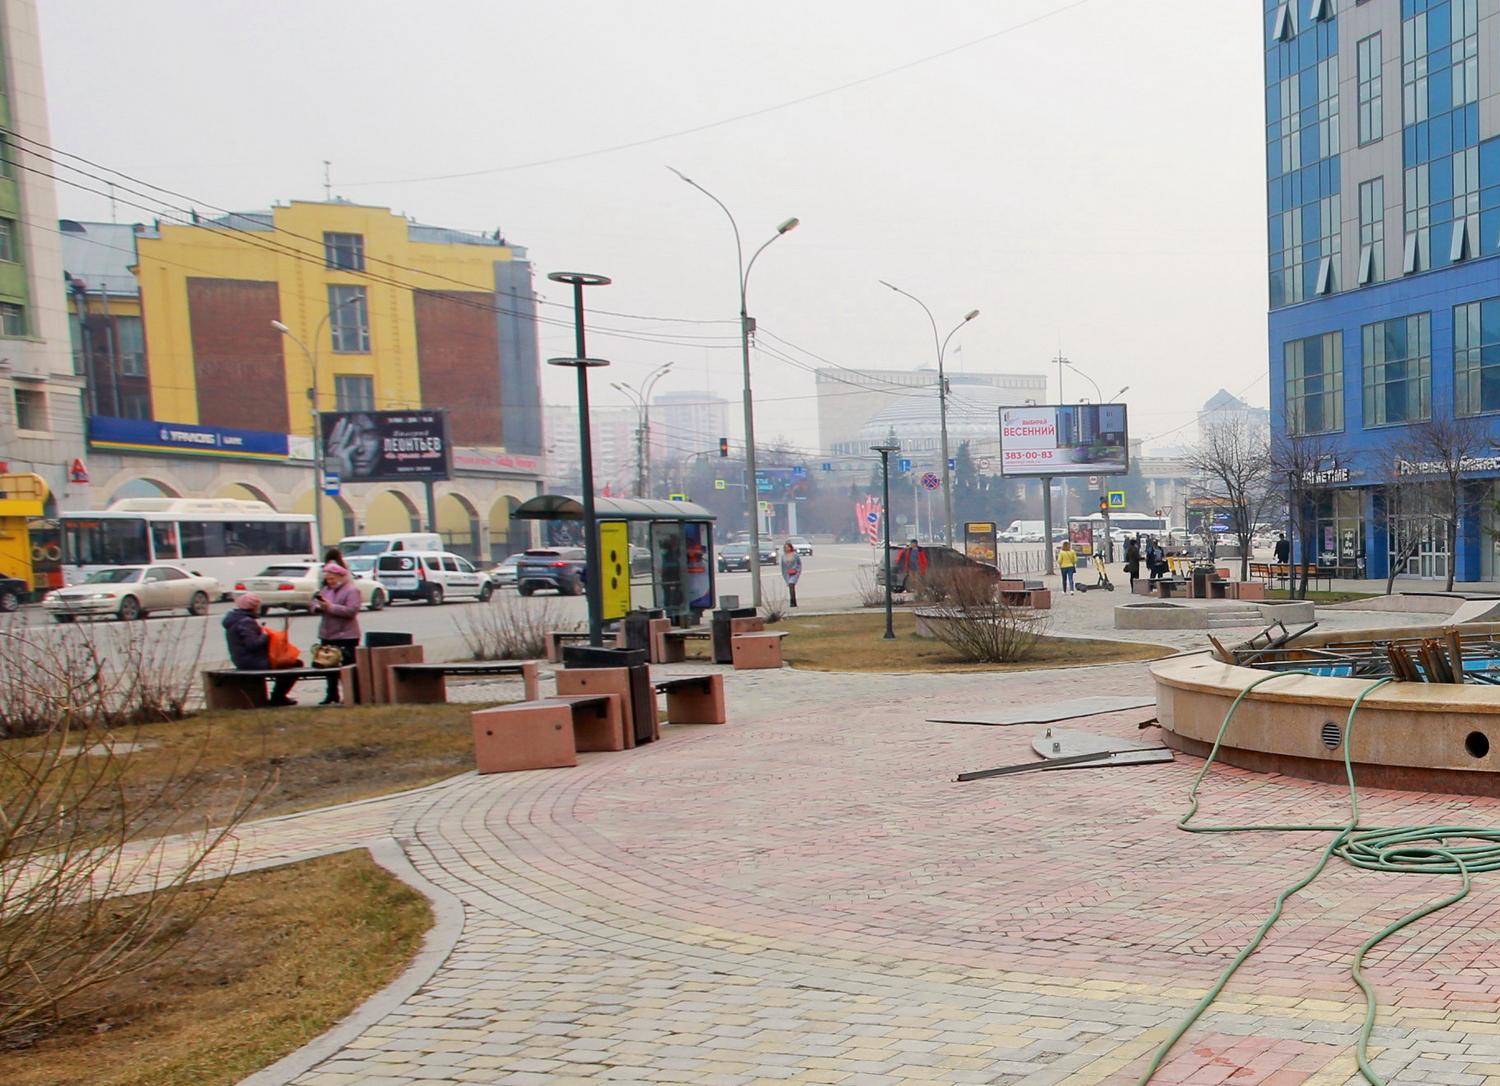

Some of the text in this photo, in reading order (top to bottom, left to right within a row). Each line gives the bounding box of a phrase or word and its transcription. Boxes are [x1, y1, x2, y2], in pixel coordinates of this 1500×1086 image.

[1003, 425, 1055, 437] ВЕСЕННИЙ
[383, 437, 442, 453] ЛЕОНТЬЕВ
[1004, 451, 1053, 460] 383-00-83
